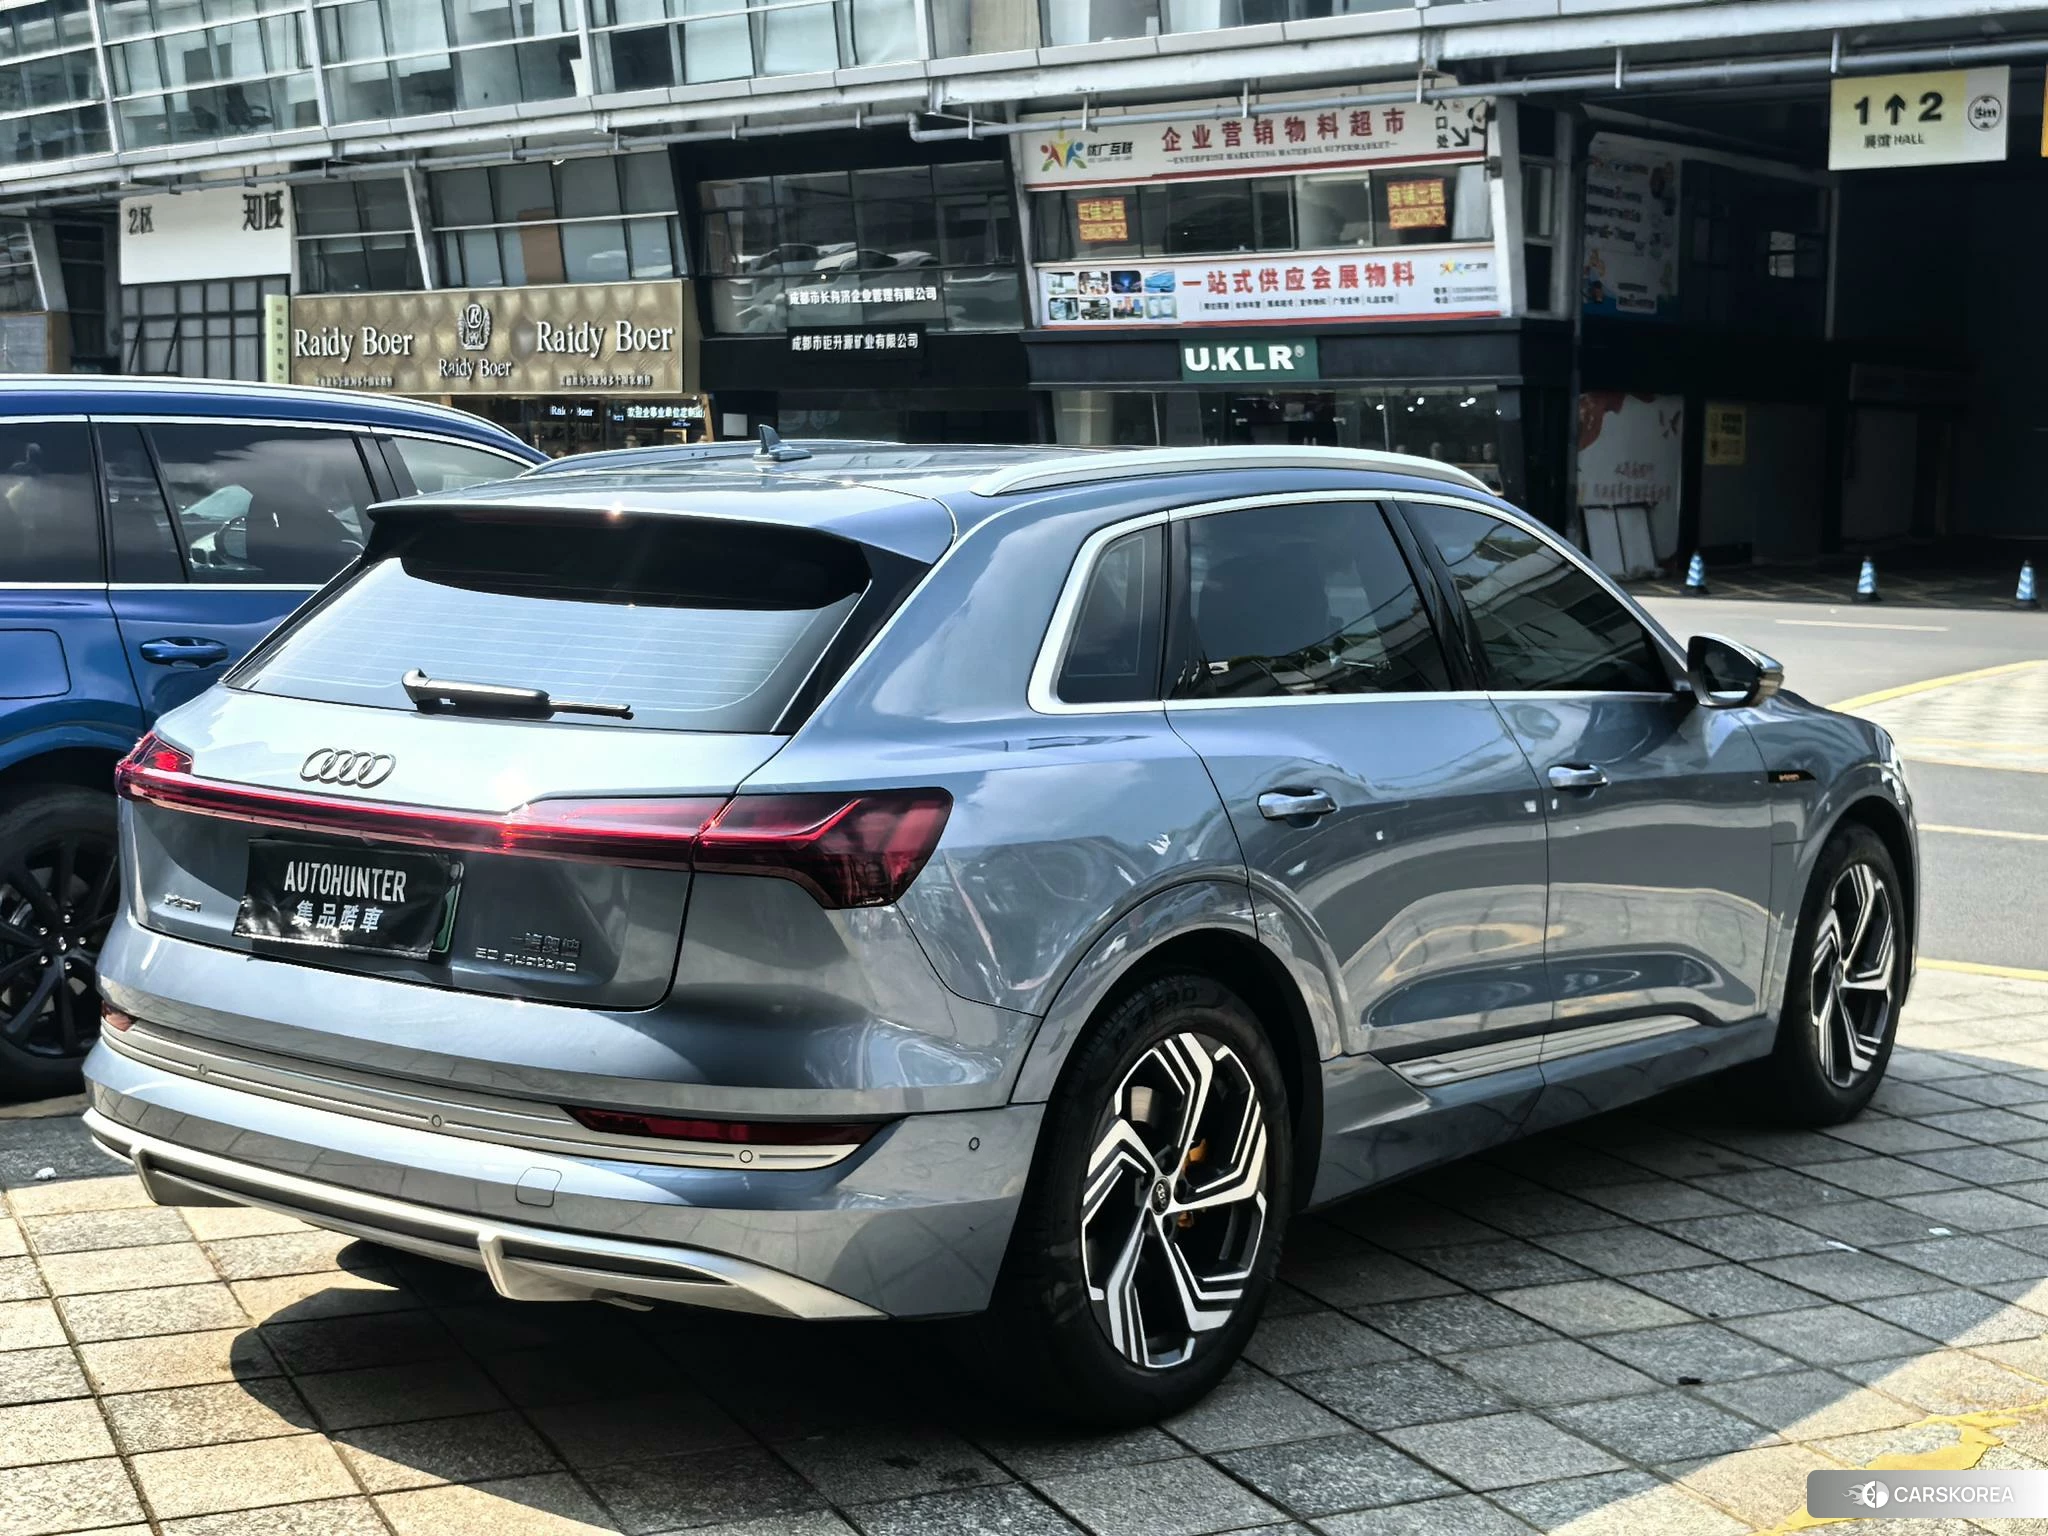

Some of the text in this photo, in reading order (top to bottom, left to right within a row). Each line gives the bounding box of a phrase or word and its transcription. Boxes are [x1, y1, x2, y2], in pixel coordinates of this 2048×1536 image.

[1854, 91, 1944, 126] 1 2
[1162, 107, 1405, 152] 企业营销物料超市
[1182, 260, 1415, 295] 一站式供应会展物料
[294, 327, 355, 363] Raidy
[361, 325, 413, 356] Boer
[537, 319, 673, 359] Raidy Boer
[439, 357, 512, 381] Raidy Boer
[283, 860, 407, 903] AUTOHUNTER
